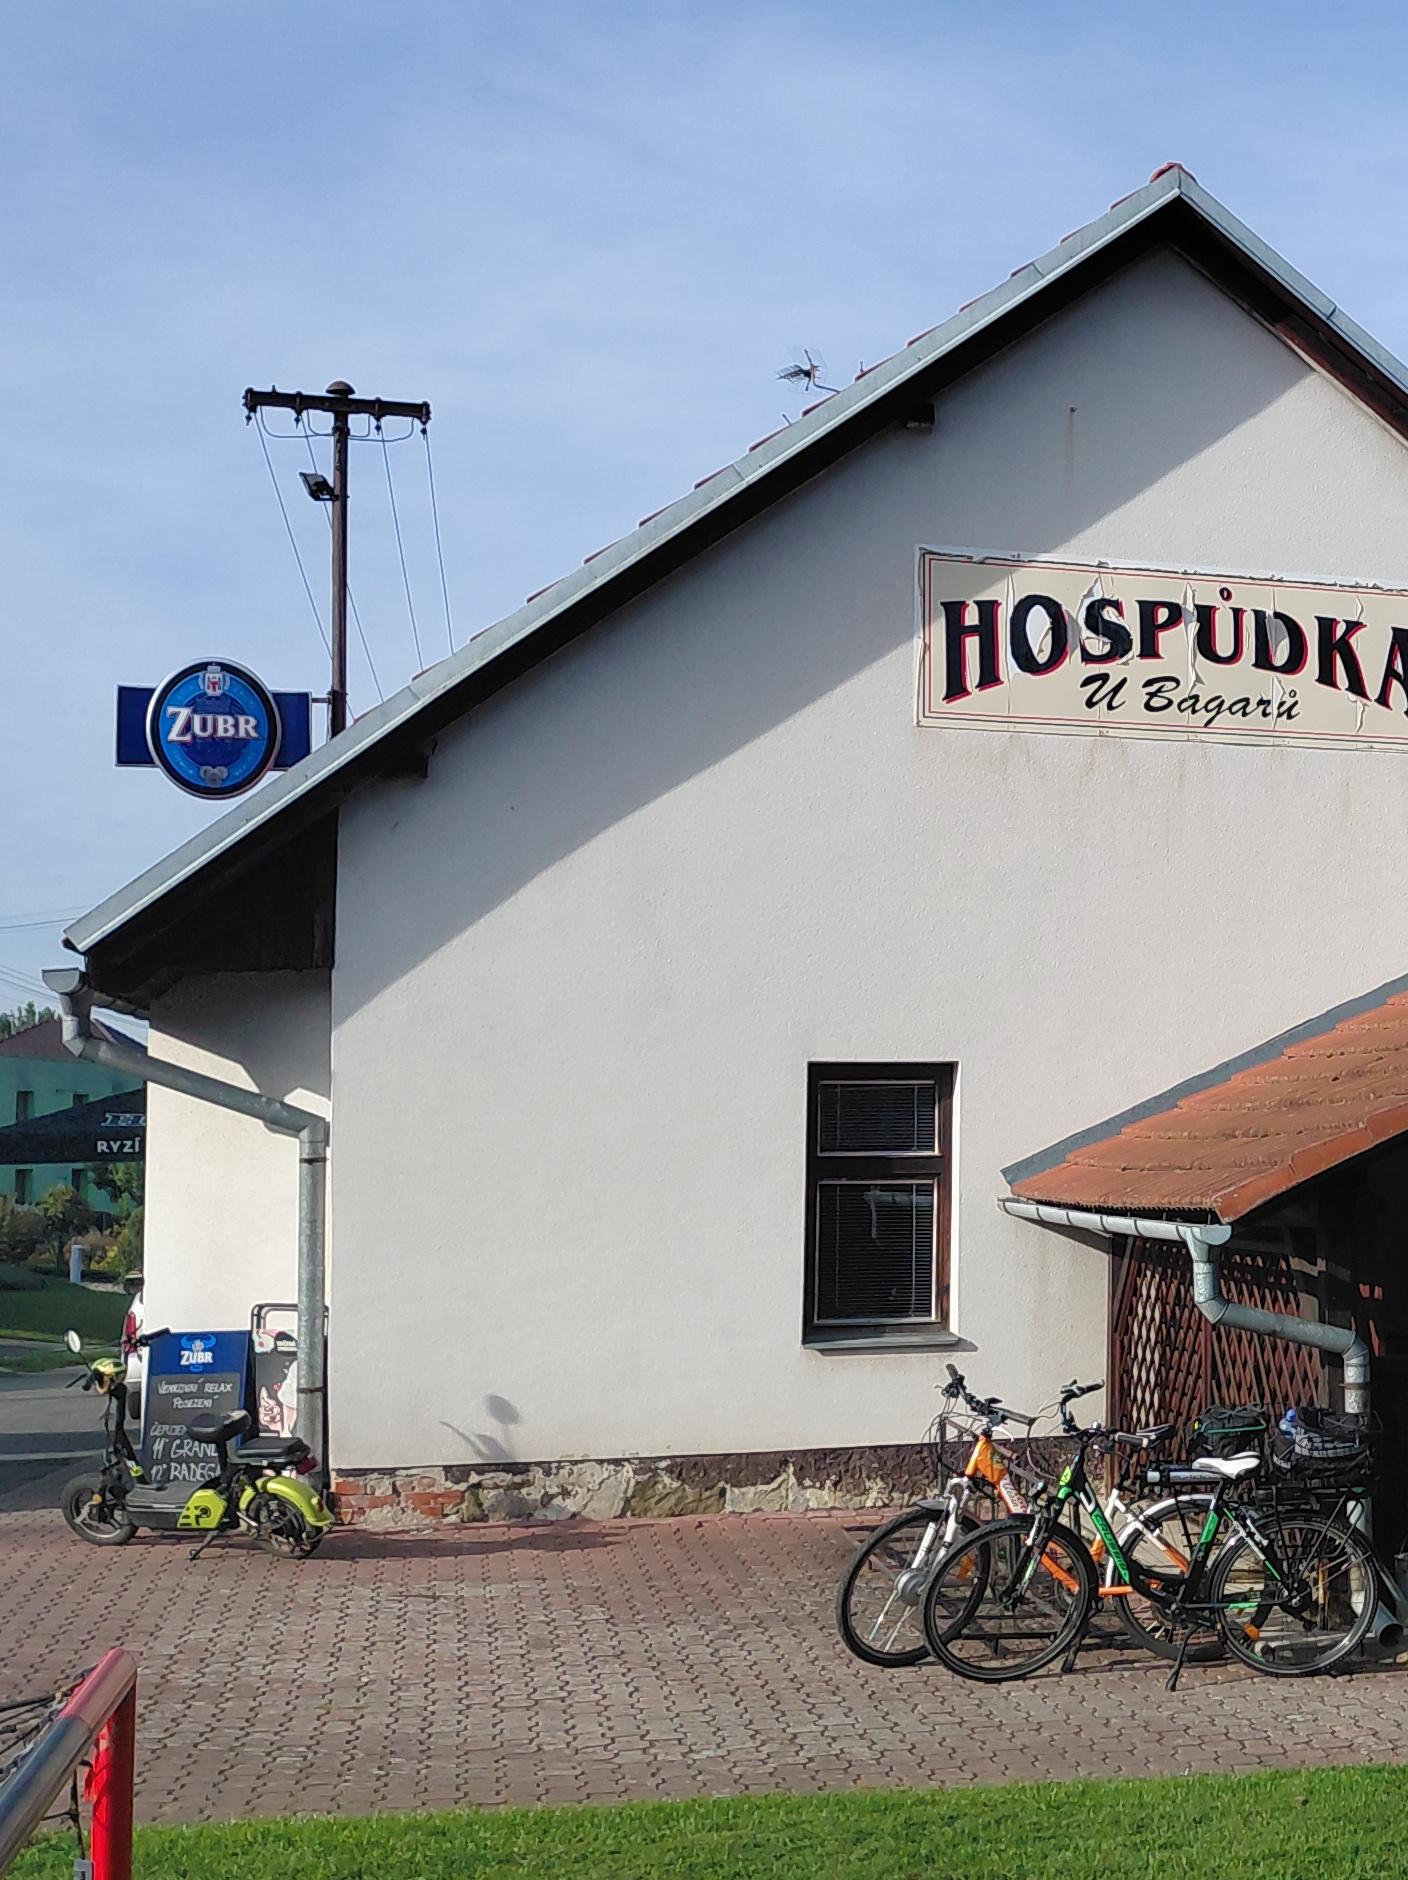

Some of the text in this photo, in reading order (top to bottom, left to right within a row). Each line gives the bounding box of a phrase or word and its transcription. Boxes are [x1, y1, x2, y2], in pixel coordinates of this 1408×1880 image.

[1079, 673, 1128, 711] U
[96, 1137, 141, 1153] RYZÍ
[179, 1351, 213, 1365] ZUBR
